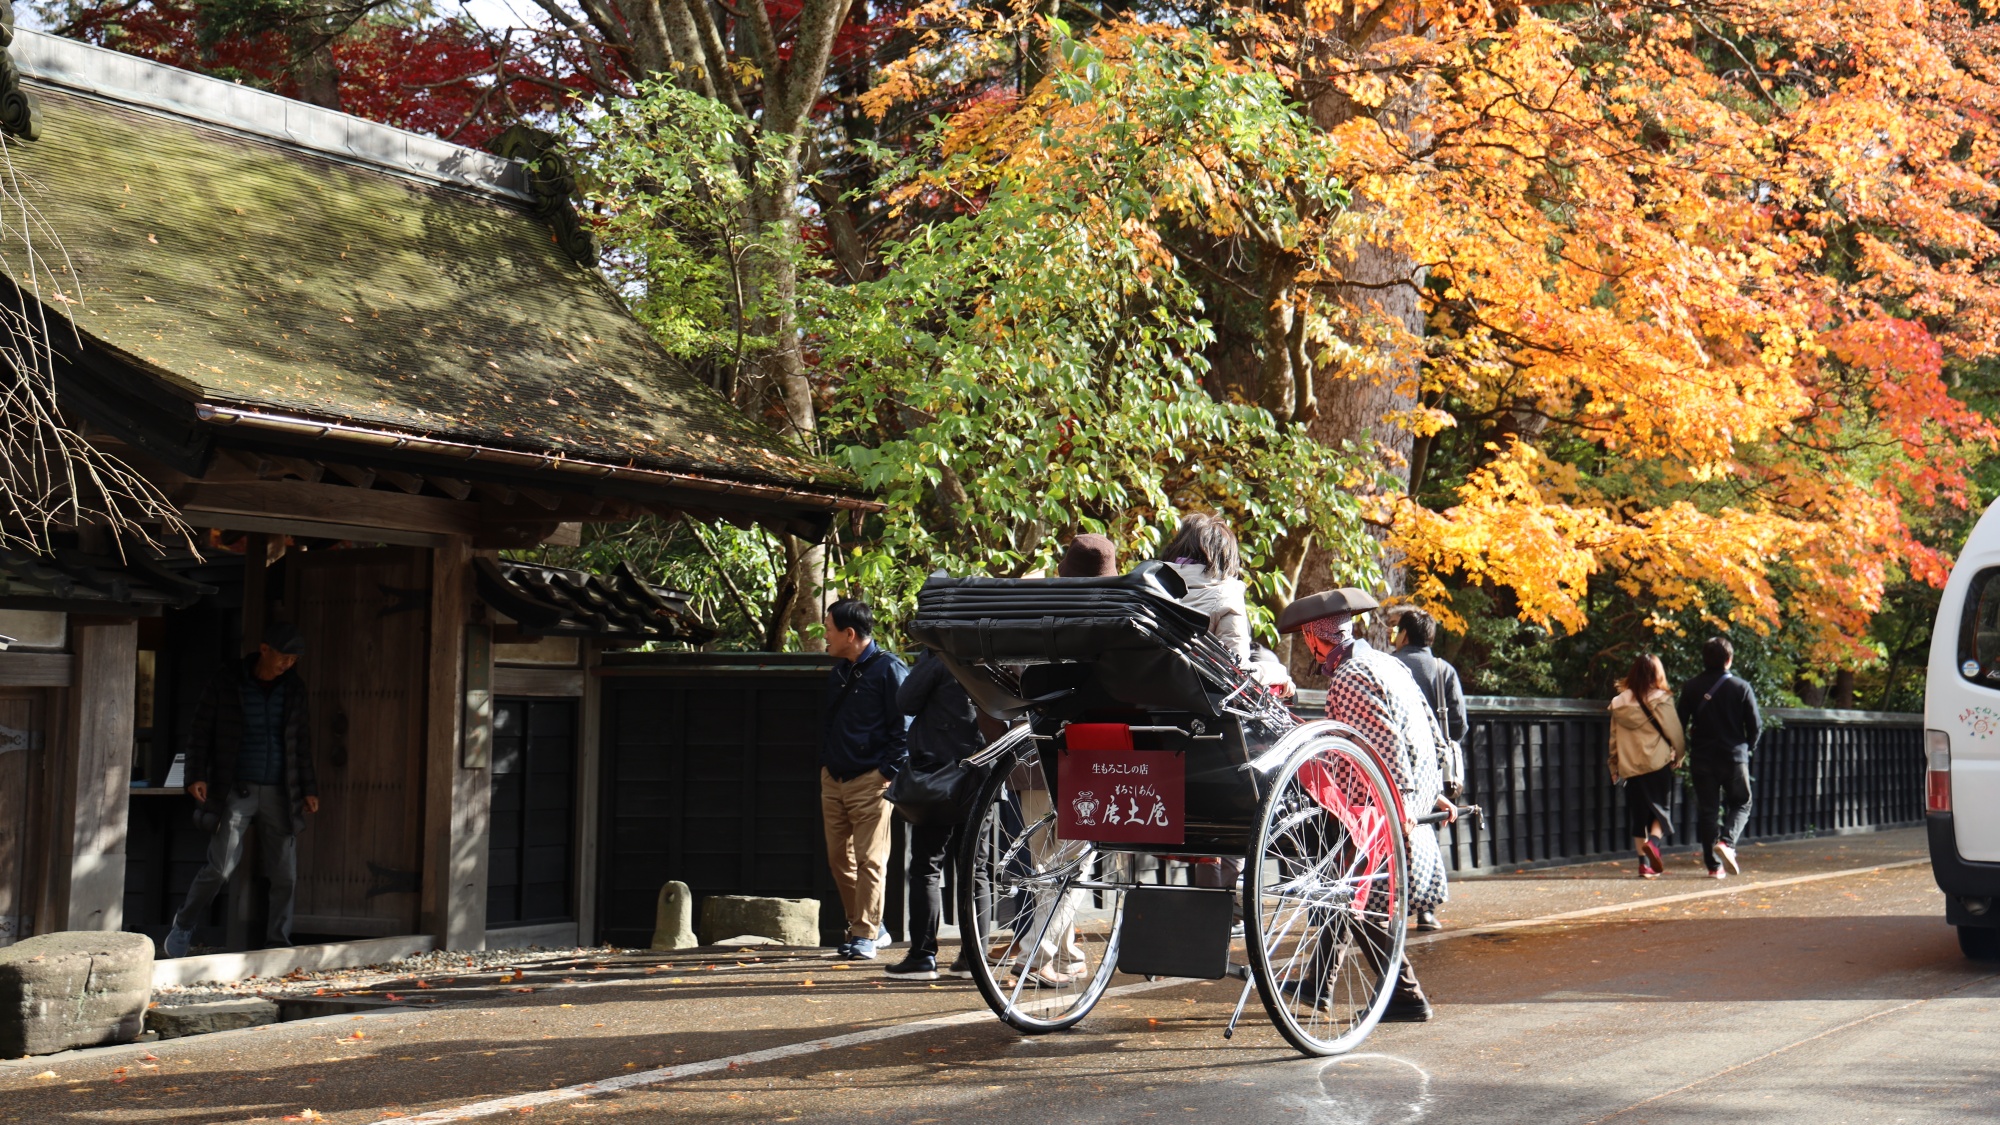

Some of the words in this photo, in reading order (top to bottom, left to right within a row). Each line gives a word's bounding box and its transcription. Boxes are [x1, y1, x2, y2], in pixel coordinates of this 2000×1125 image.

[1092, 763, 1149, 775] 生もろこしの店
[1115, 783, 1155, 797] もろこしあん
[1102, 794, 1169, 827] 唐土庵
